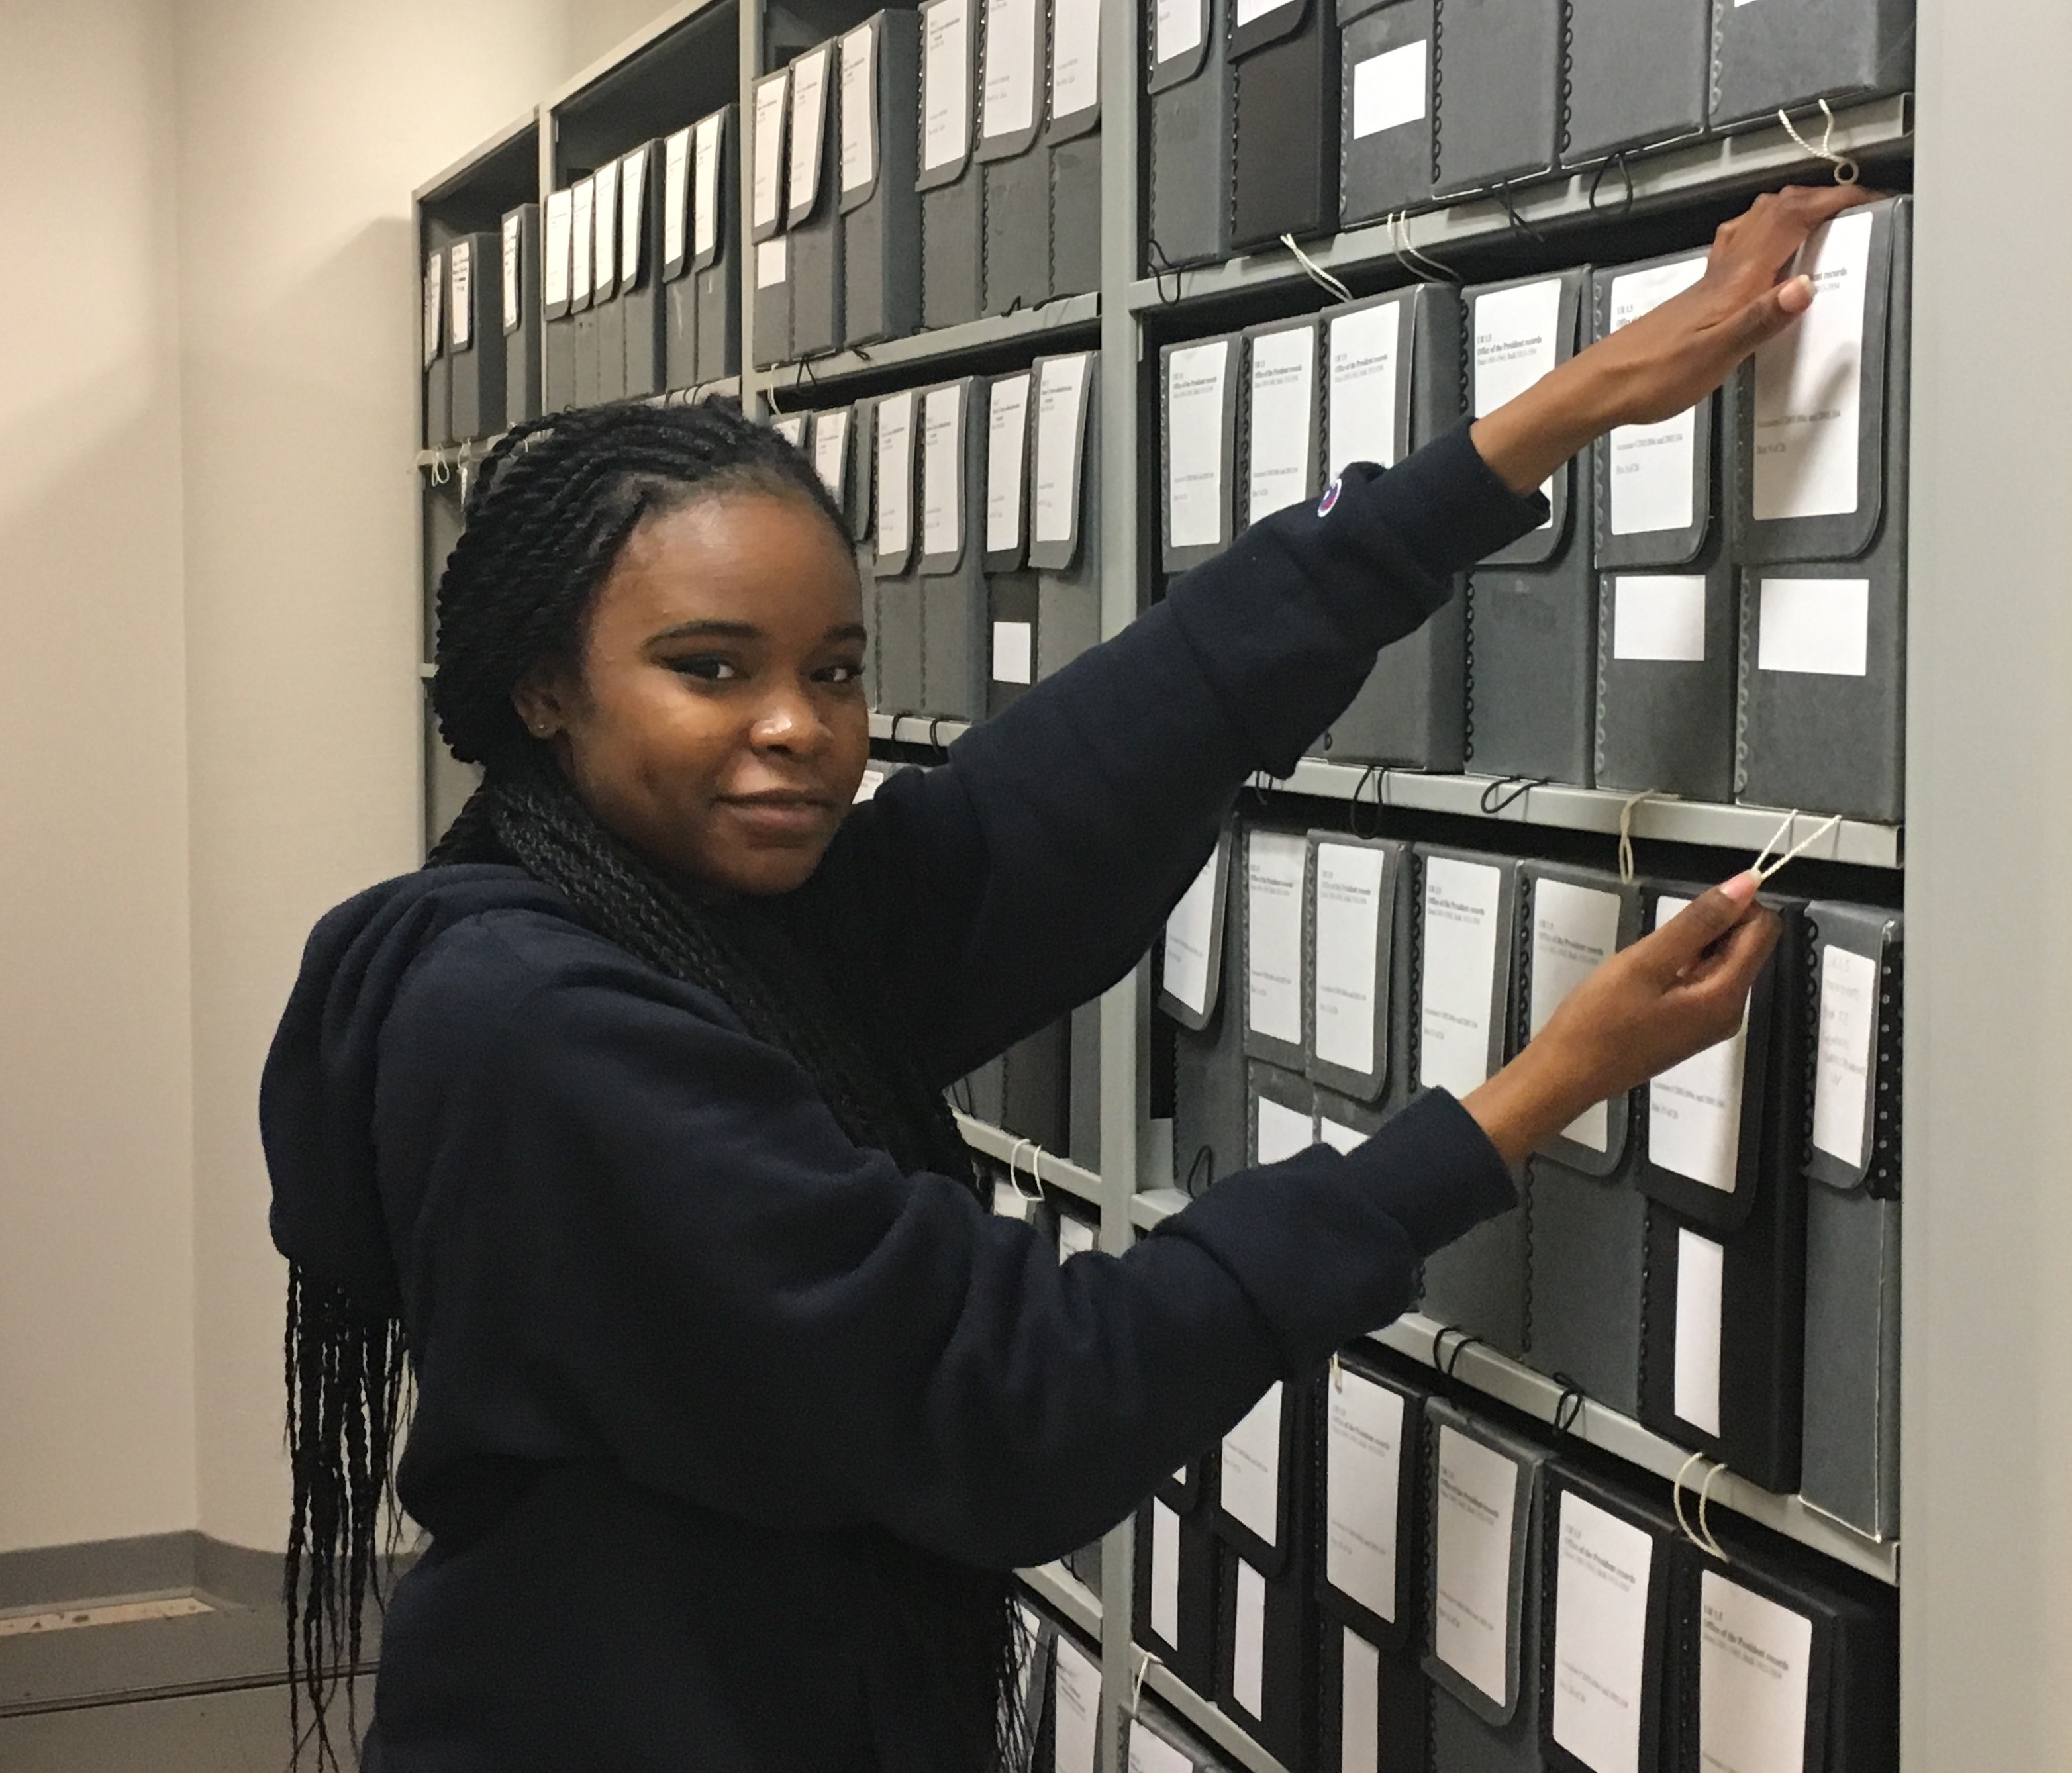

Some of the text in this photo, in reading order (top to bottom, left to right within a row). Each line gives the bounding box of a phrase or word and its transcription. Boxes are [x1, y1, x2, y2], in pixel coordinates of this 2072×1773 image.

[1477, 346, 1489, 356] Office
[1503, 340, 1524, 350] President
[1525, 335, 1542, 345] records
[1565, 1537, 1579, 1551] Office
[1593, 1553, 1616, 1573] President
[1616, 1568, 1636, 1584] records
[1703, 1619, 1720, 1634] Office
[1738, 1636, 1765, 1658] President
[1766, 1653, 1789, 1671] records
